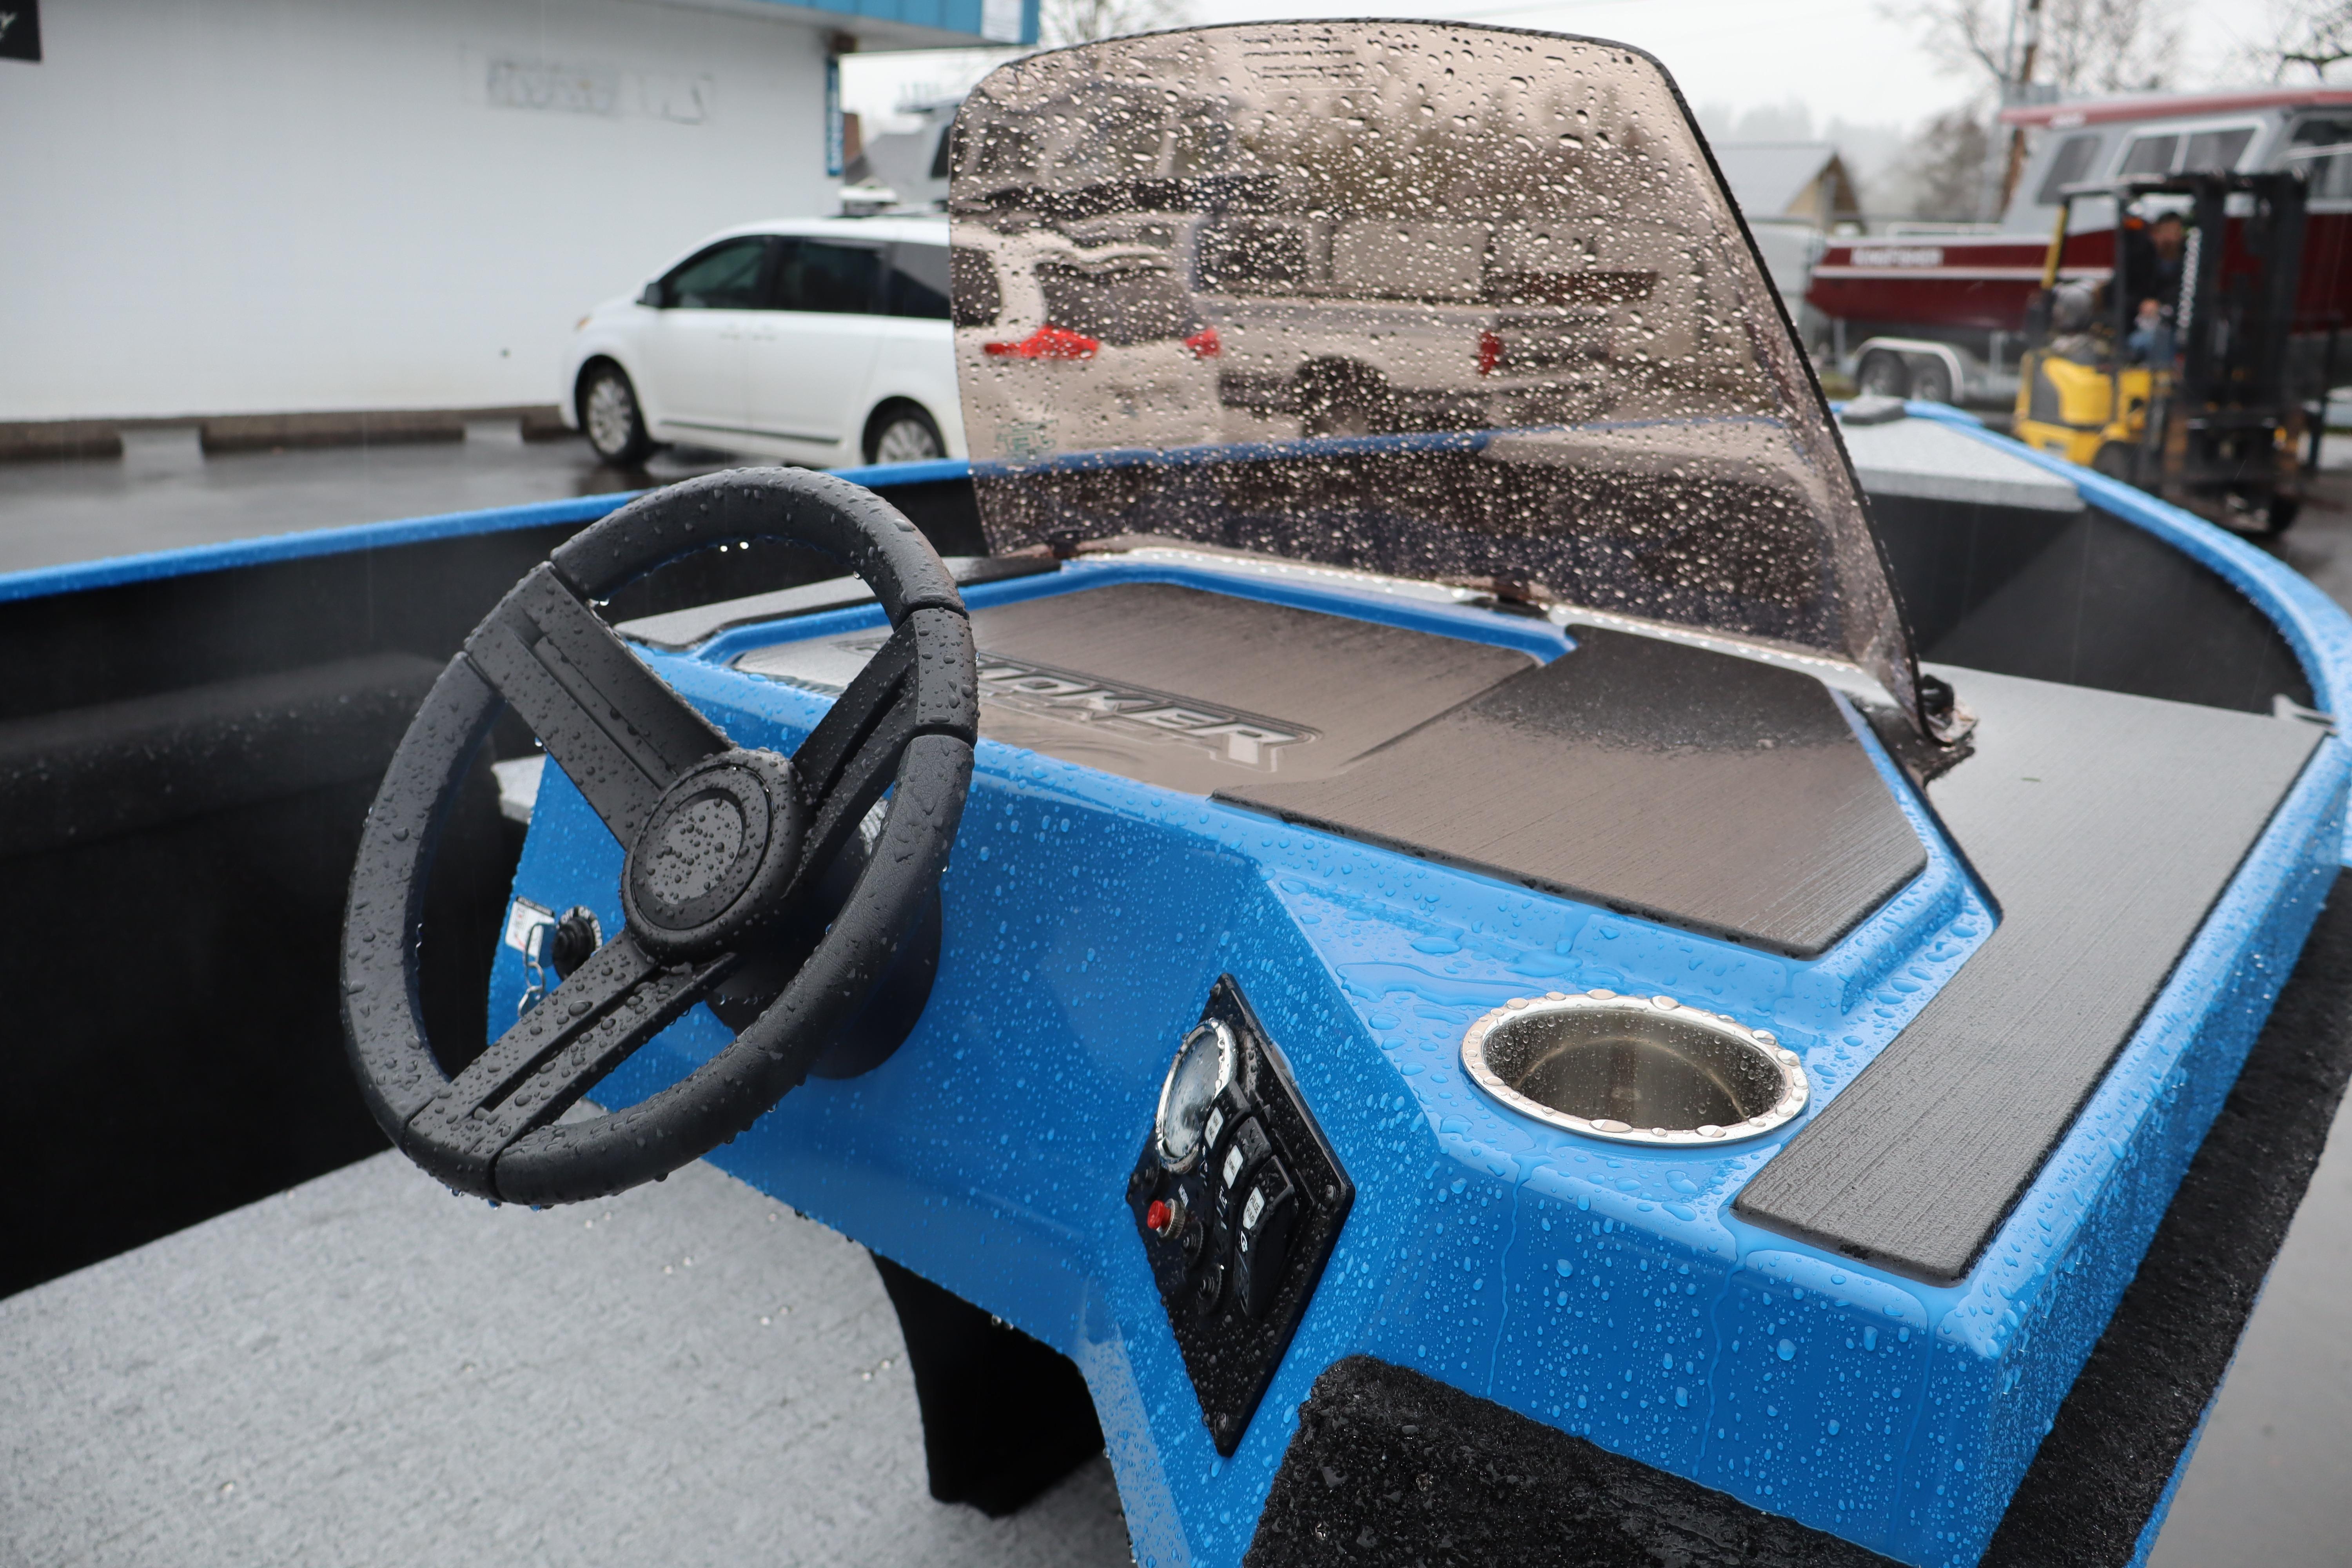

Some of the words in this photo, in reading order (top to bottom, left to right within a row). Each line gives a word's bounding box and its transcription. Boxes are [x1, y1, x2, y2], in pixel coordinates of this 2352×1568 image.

[560, 907, 575, 924] OFF
[578, 906, 591, 920] ON
[1178, 1183, 1189, 1207] HORN
[1250, 1195, 1260, 1214] BILGE
[1246, 1205, 1255, 1223] PUMP
